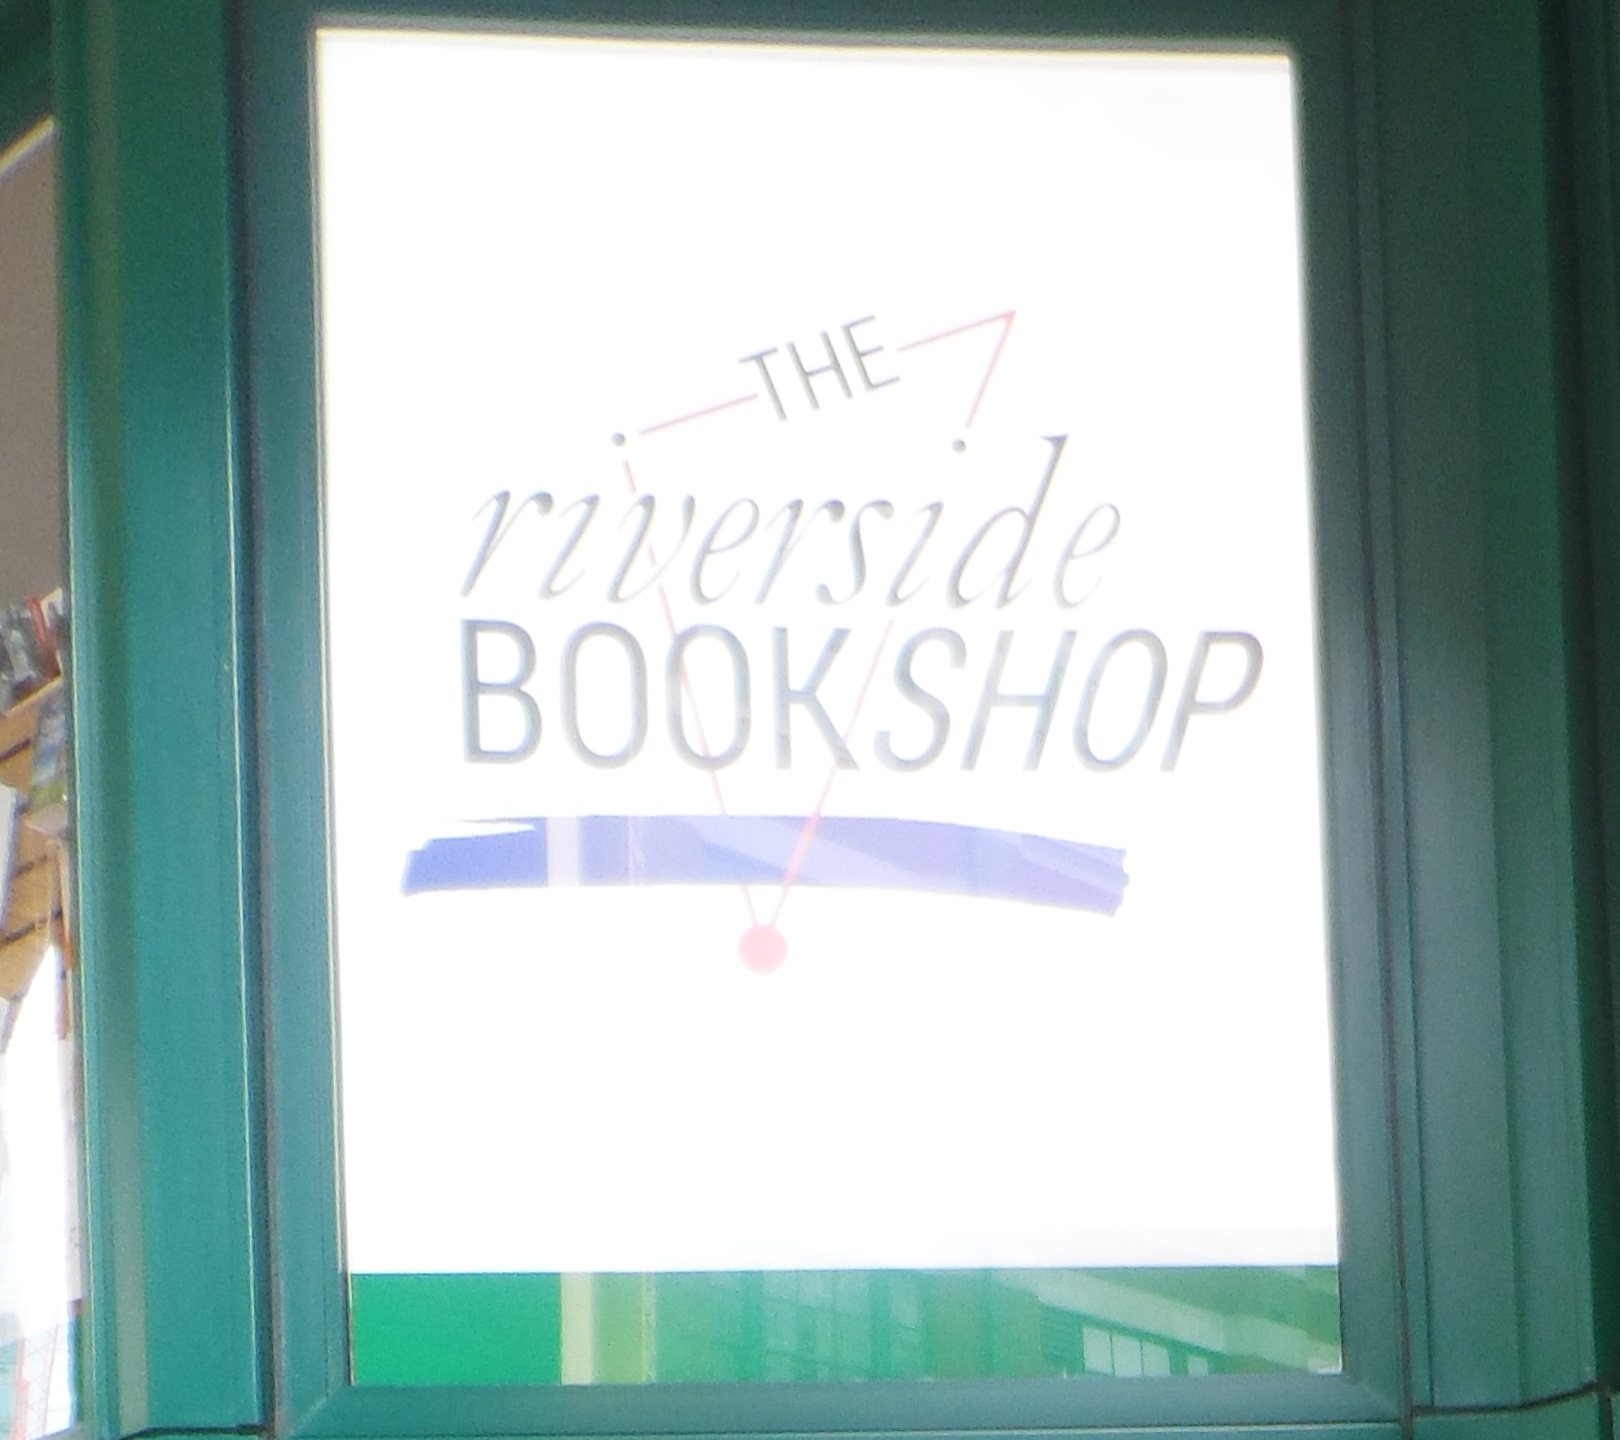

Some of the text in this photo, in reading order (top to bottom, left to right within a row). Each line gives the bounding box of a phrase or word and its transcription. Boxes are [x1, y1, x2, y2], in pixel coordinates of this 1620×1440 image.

[739, 315, 899, 421] THE
[461, 434, 1121, 608] riverside
[461, 619, 1264, 772] BOOKSHOP
